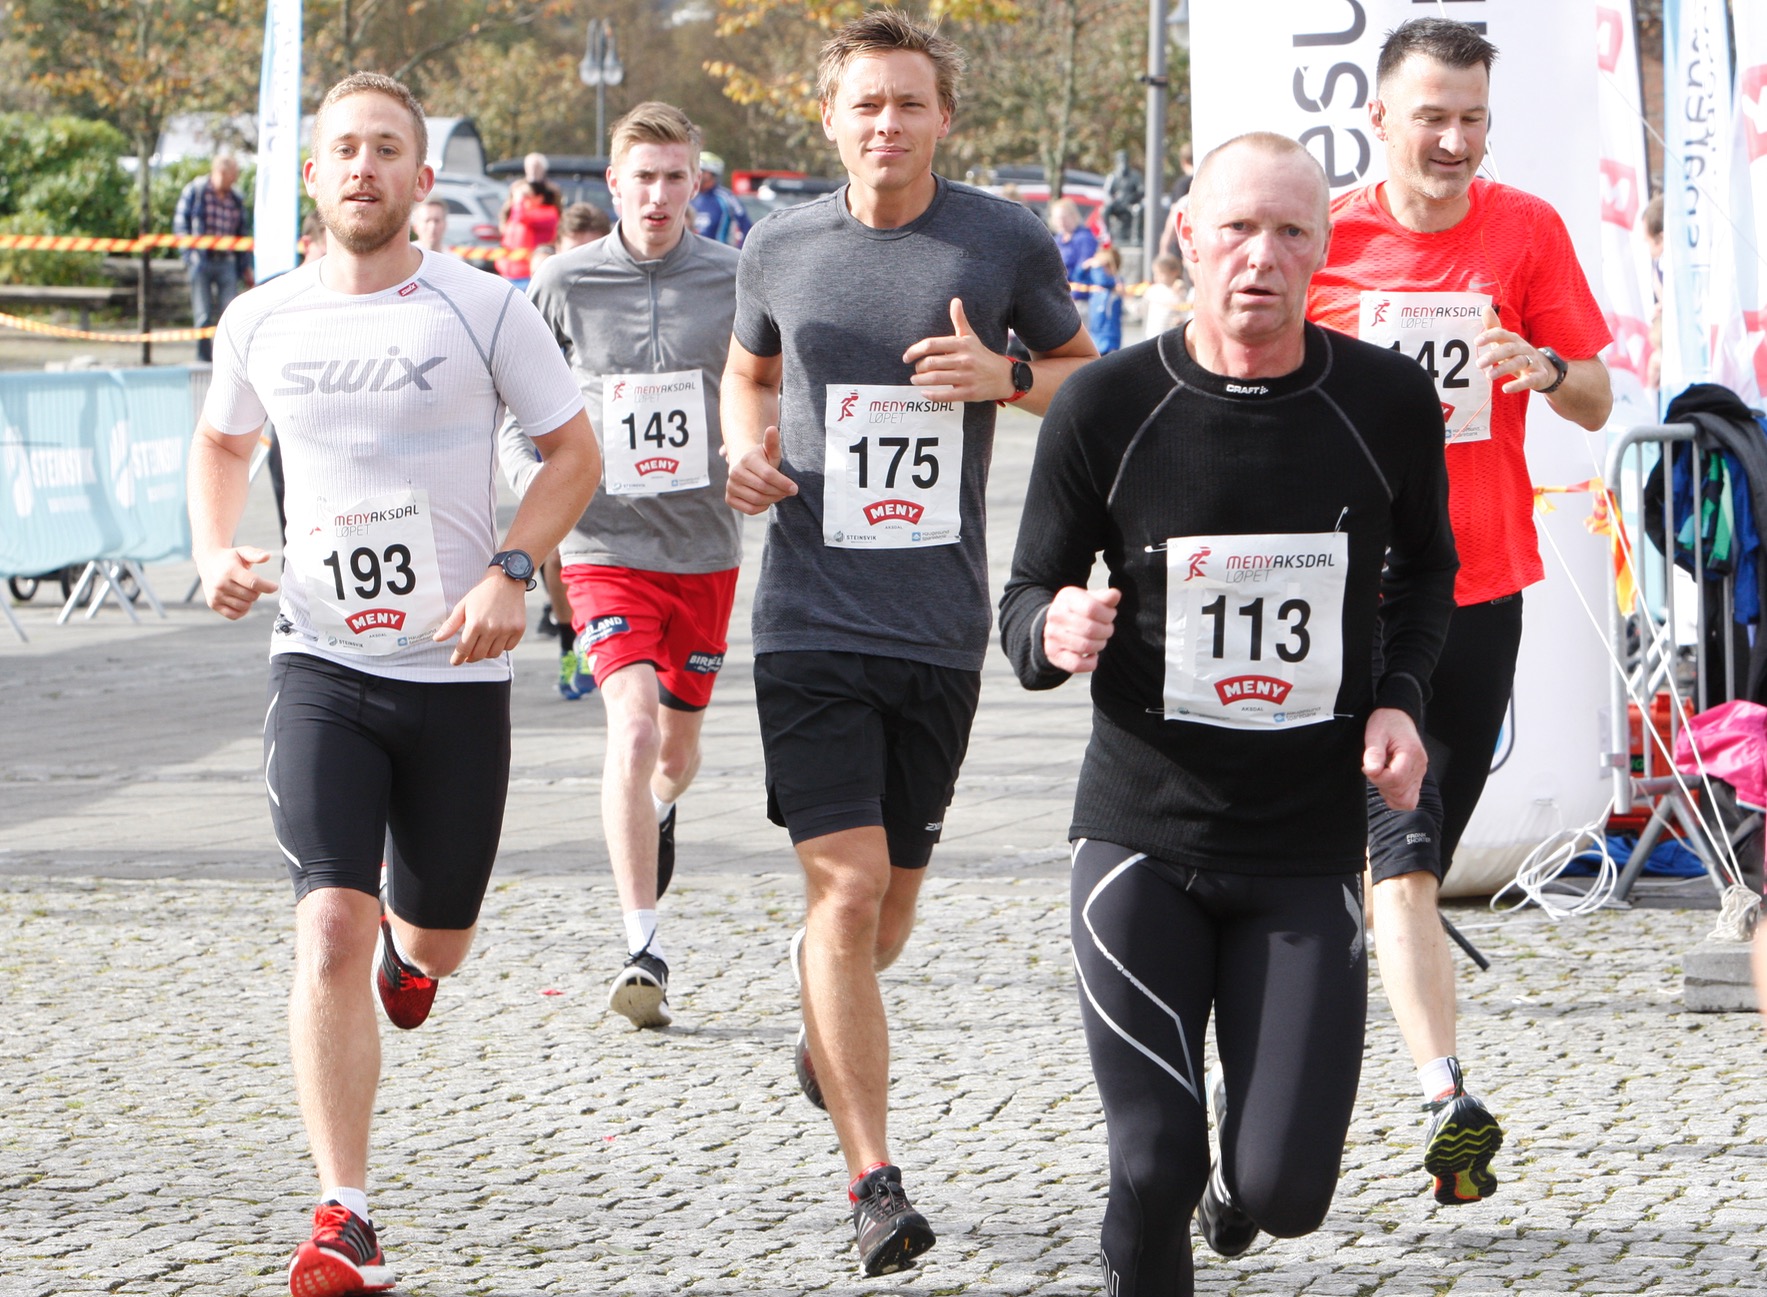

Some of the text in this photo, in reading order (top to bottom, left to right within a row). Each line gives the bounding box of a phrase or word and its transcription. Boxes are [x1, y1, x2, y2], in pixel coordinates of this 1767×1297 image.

[1401, 306, 1482, 318] MENYAKSDAL
[1401, 318, 1436, 329] LØPET
[1389, 339, 1470, 388] 42
[634, 382, 696, 395] MENYAKSDAL
[1226, 384, 1260, 394] CRAFT
[869, 401, 954, 412] MENYAKSDAL
[868, 412, 906, 424] LØPET
[622, 409, 689, 450] 143
[639, 459, 676, 473] MENY
[849, 436, 940, 489] 175
[334, 504, 420, 527] MENYAKSDAL
[869, 504, 919, 520] MENY
[335, 523, 372, 538] LØPET
[1225, 553, 1335, 570] MENYAKSDAL
[323, 543, 416, 600] 193
[1225, 568, 1273, 584] LØPET
[352, 612, 401, 630] MENY
[1201, 594, 1311, 663] 113
[1223, 680, 1286, 698] MENY
